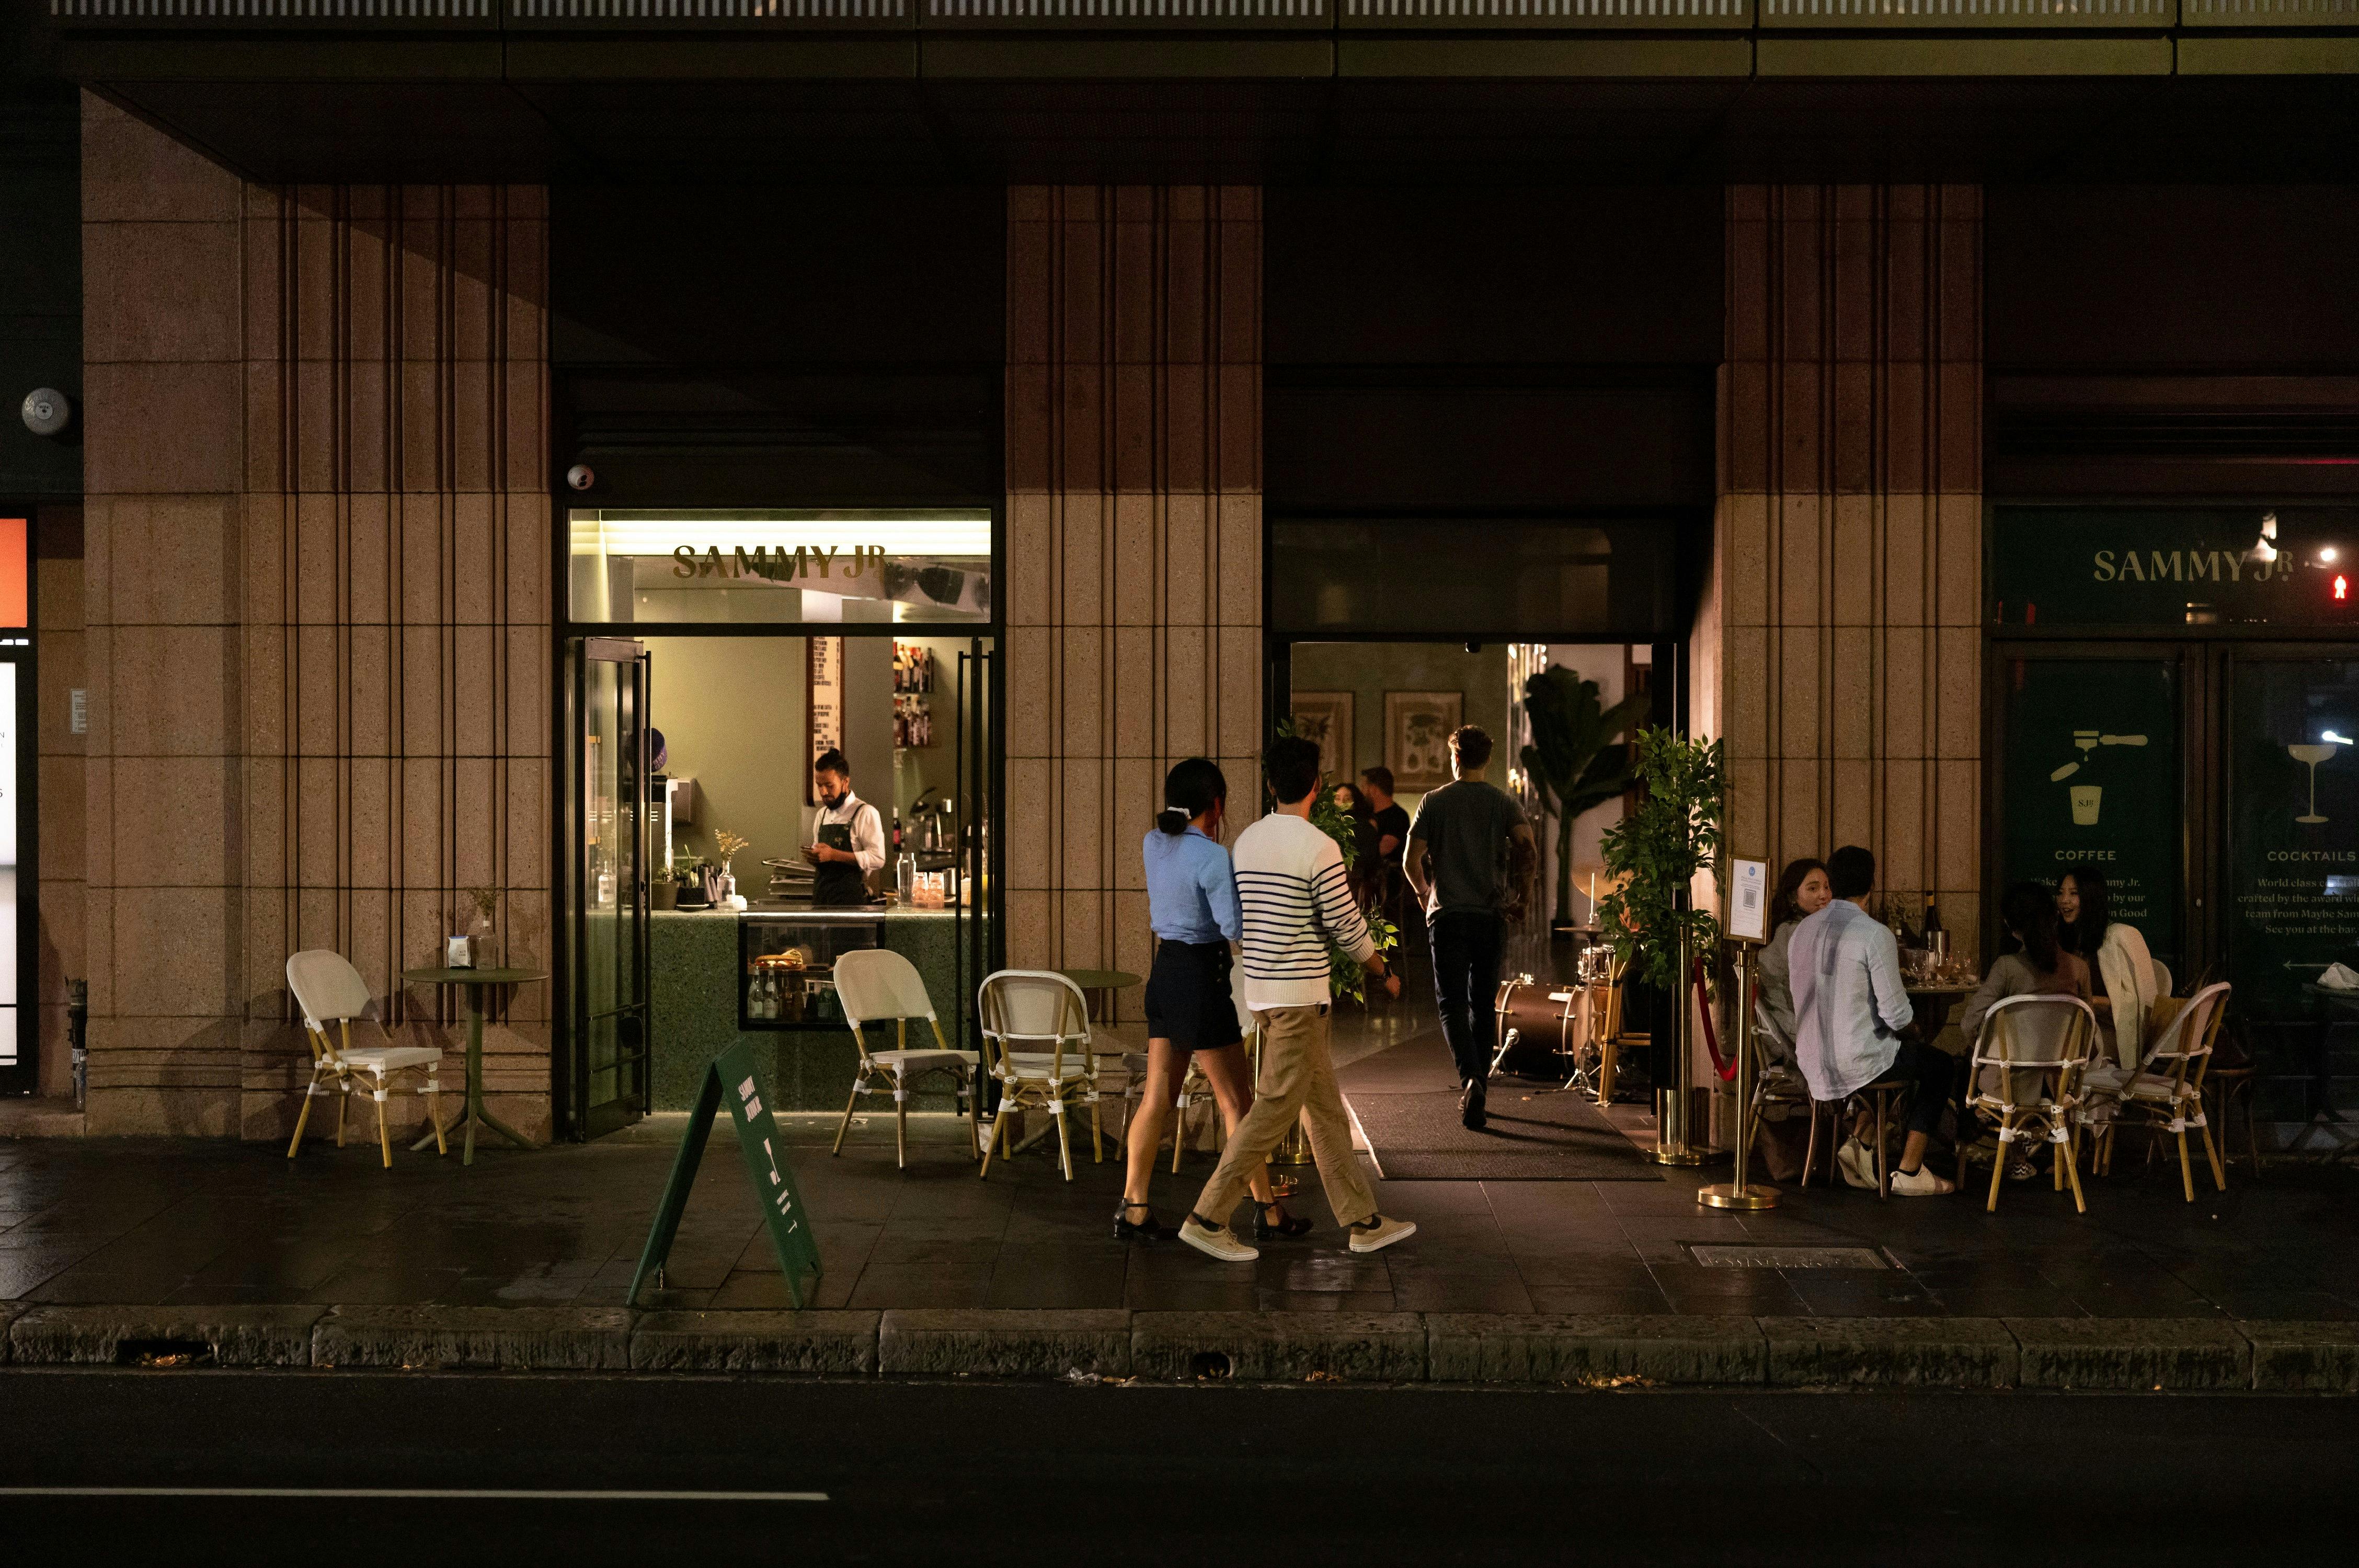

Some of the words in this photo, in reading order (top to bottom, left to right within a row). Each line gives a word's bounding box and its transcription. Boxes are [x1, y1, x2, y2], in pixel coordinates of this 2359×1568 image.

[673, 545, 839, 578] SAMMY
[2094, 550, 2249, 582] SAMMY
[2055, 850, 2116, 861] COFFEE
[2267, 851, 2356, 862] COCKTAILS
[2127, 878, 2140, 886] Jr.
[2258, 878, 2288, 887] World
[2291, 878, 2317, 887] class
[2113, 893, 2125, 904] by
[2237, 894, 2275, 903] crafted
[2277, 894, 2290, 905] by
[2292, 894, 2308, 903] the
[2311, 894, 2342, 903] award
[2119, 908, 2147, 917] Good
[2245, 909, 2271, 918] team
[2273, 909, 2299, 918] from
[2301, 909, 2335, 920] Maybe
[2265, 925, 2283, 934] See
[2285, 927, 2305, 936] you
[2307, 925, 2317, 934] at
[2319, 925, 2337, 934] the
[2338, 925, 2357, 934] bar.
